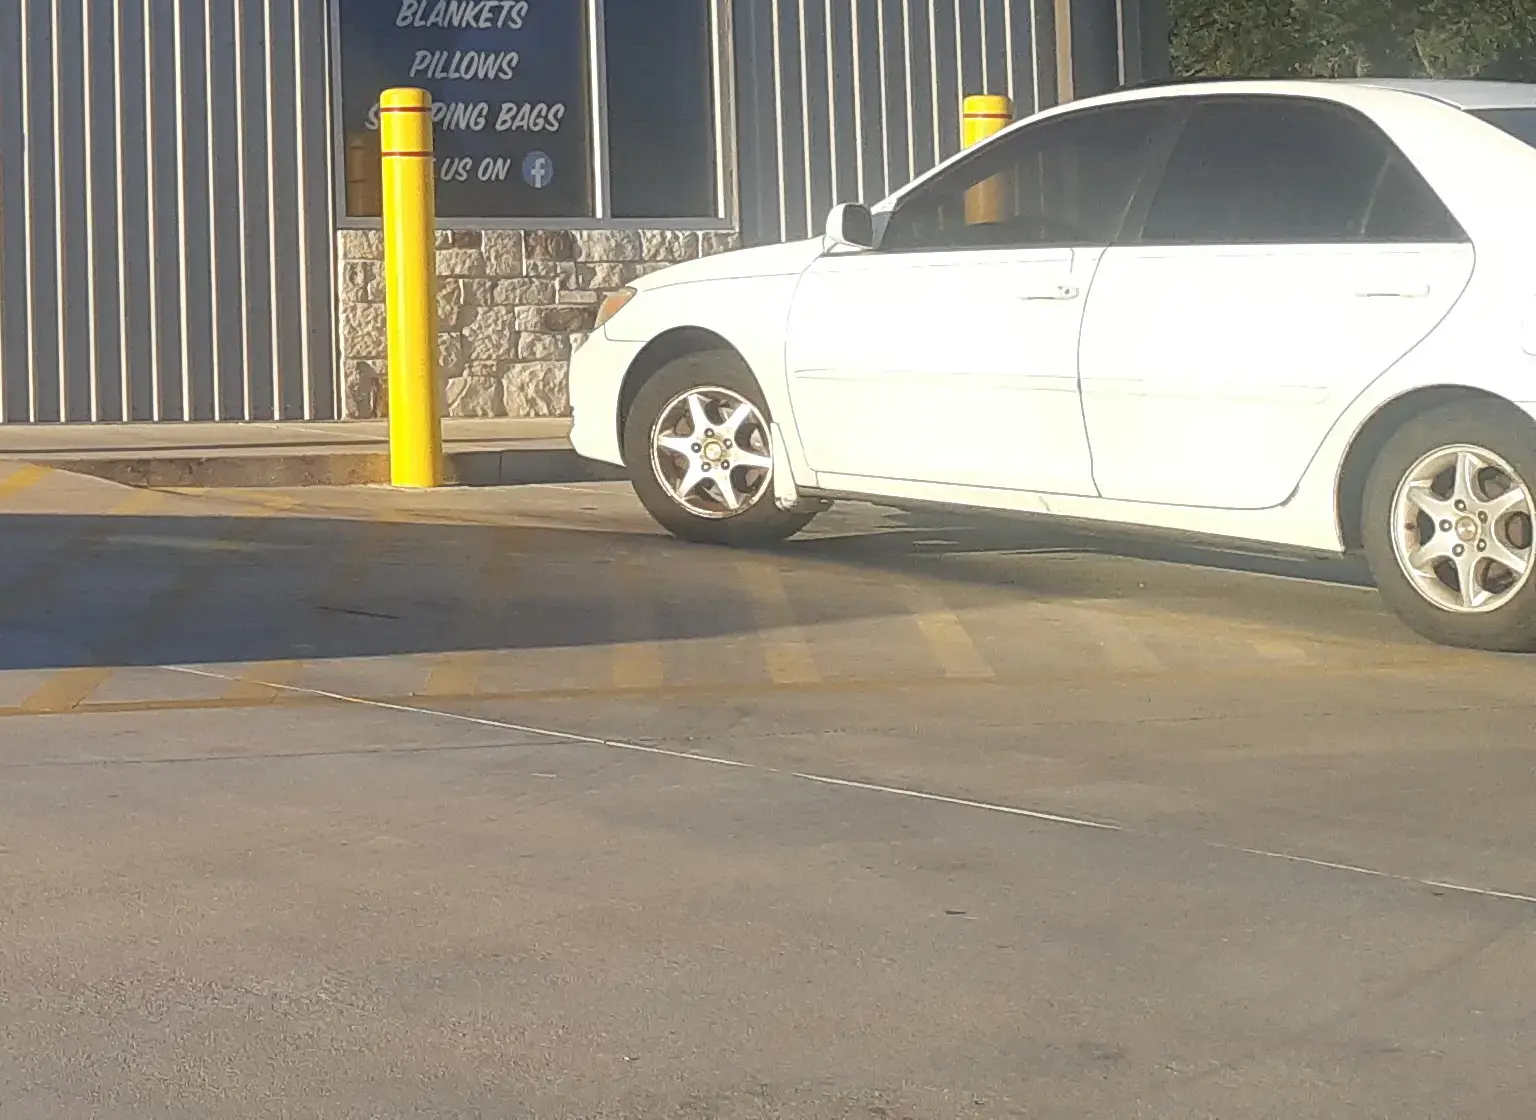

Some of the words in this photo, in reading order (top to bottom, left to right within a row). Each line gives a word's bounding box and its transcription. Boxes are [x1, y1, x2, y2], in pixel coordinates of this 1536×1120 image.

[409, 49, 520, 81] PILLOWS
[495, 102, 565, 132] BAGS
[440, 157, 473, 182] US
[477, 157, 511, 182] ON
